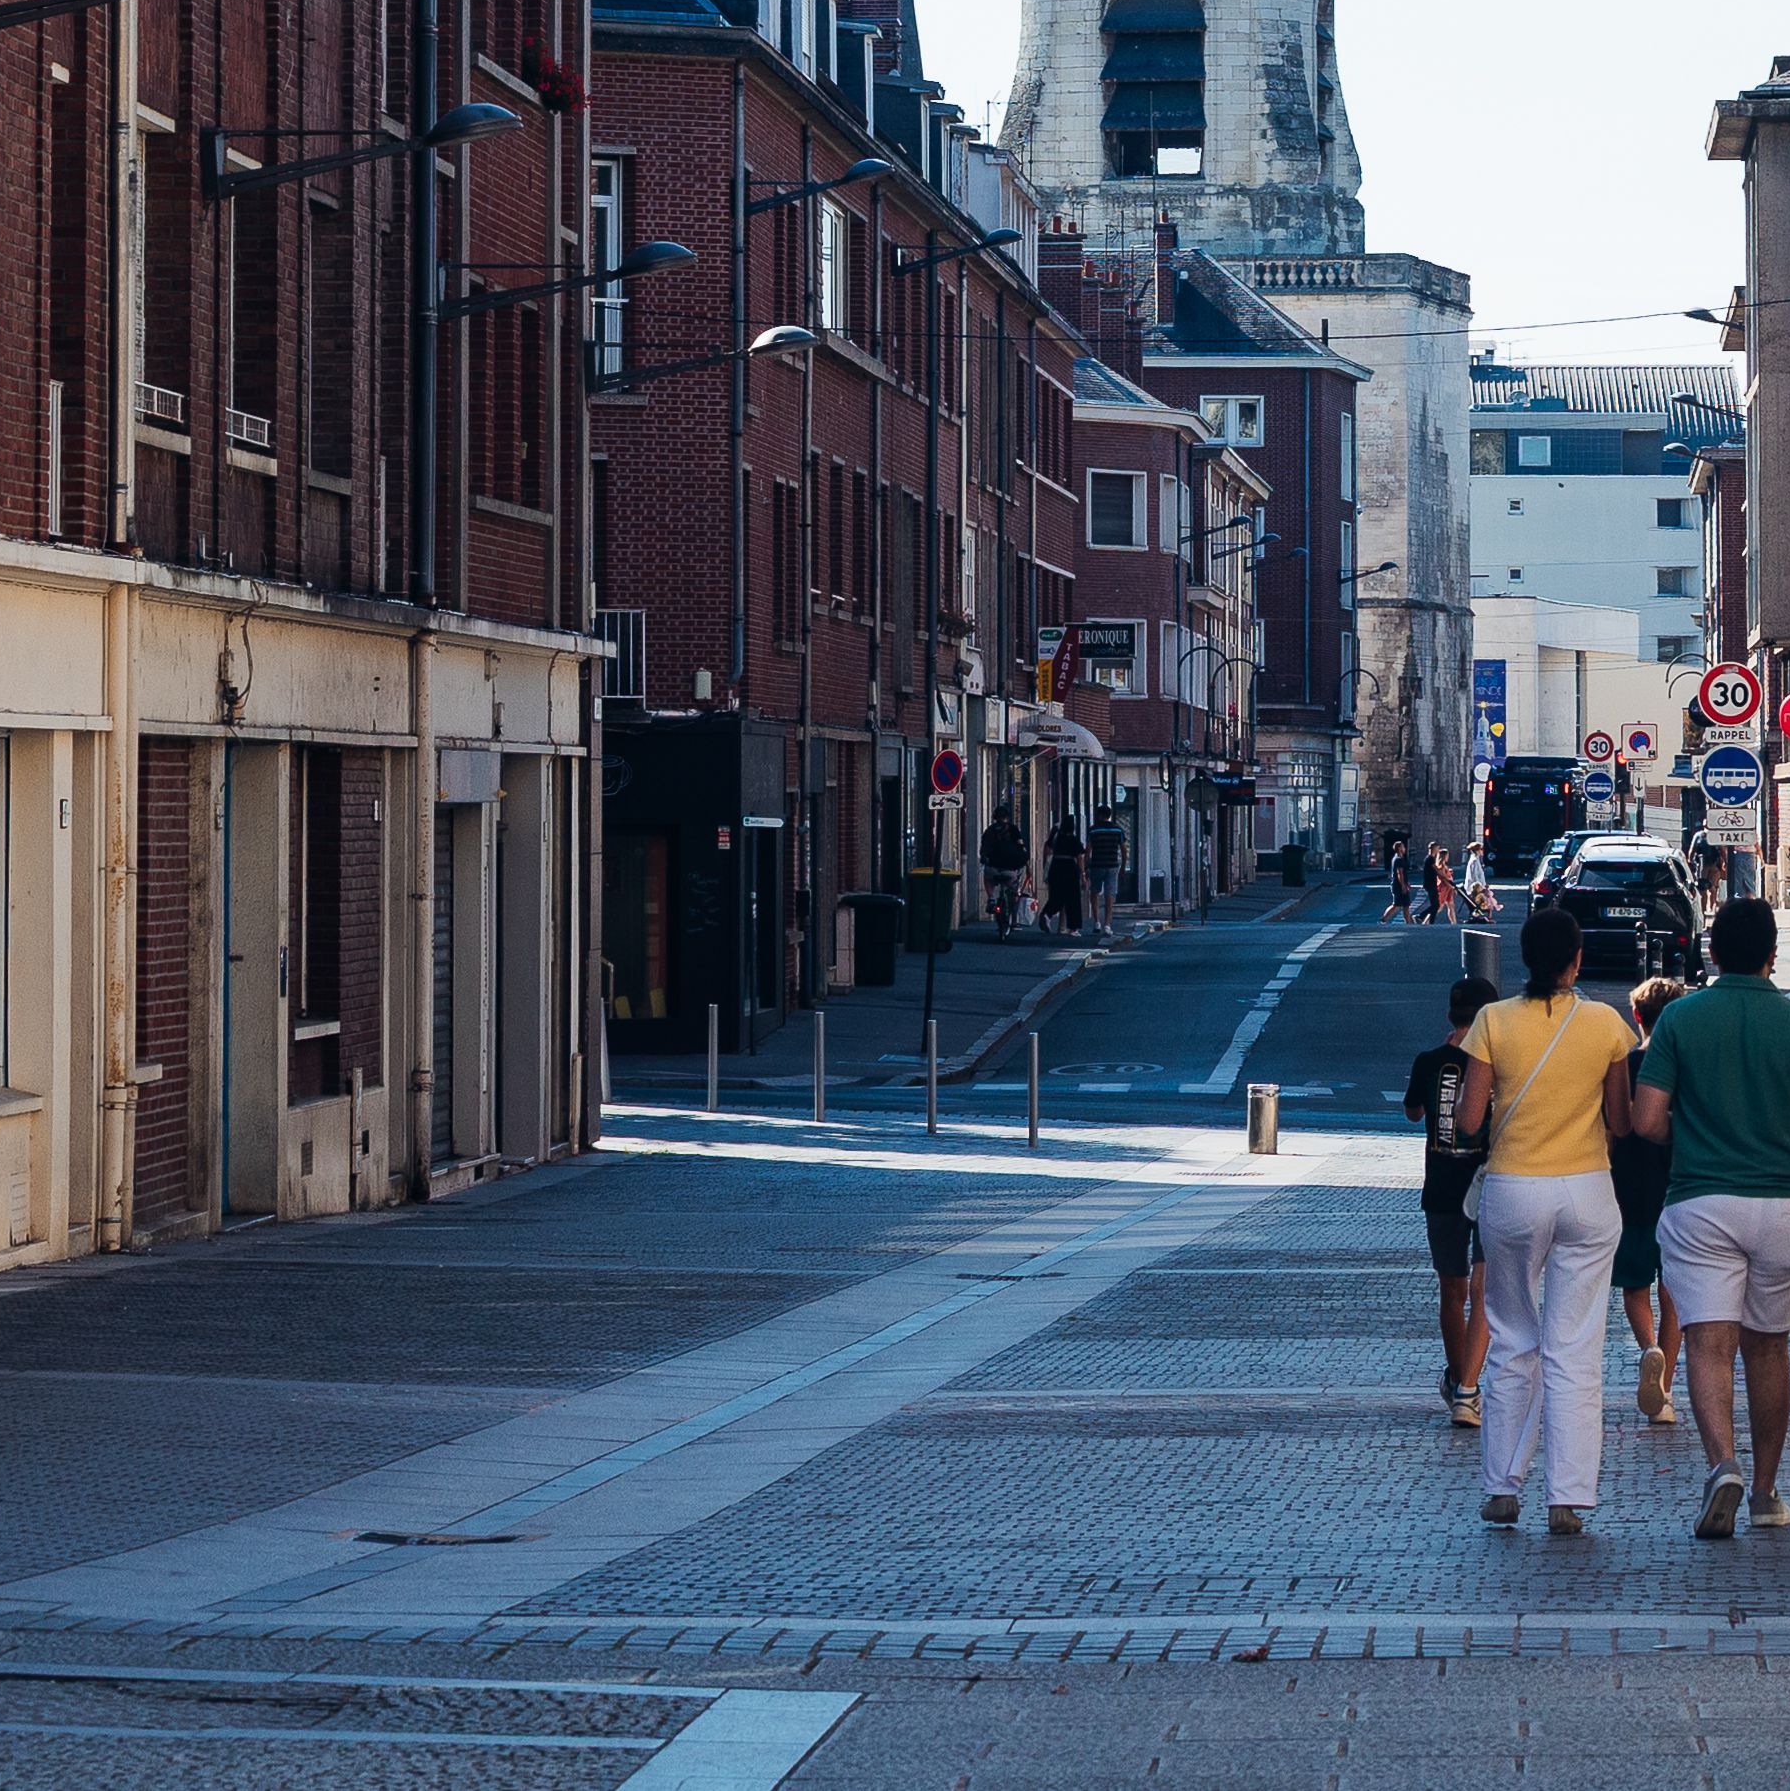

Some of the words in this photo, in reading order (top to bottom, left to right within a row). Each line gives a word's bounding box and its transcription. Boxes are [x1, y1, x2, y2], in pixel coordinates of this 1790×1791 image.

[1078, 629, 1129, 646] ERONIQUE
[1057, 642, 1074, 690] TABAC
[1712, 681, 1750, 708] 30
[1710, 730, 1751, 741] RAPPEL
[1590, 740, 1609, 755] 30
[1719, 832, 1745, 842] TAXI
